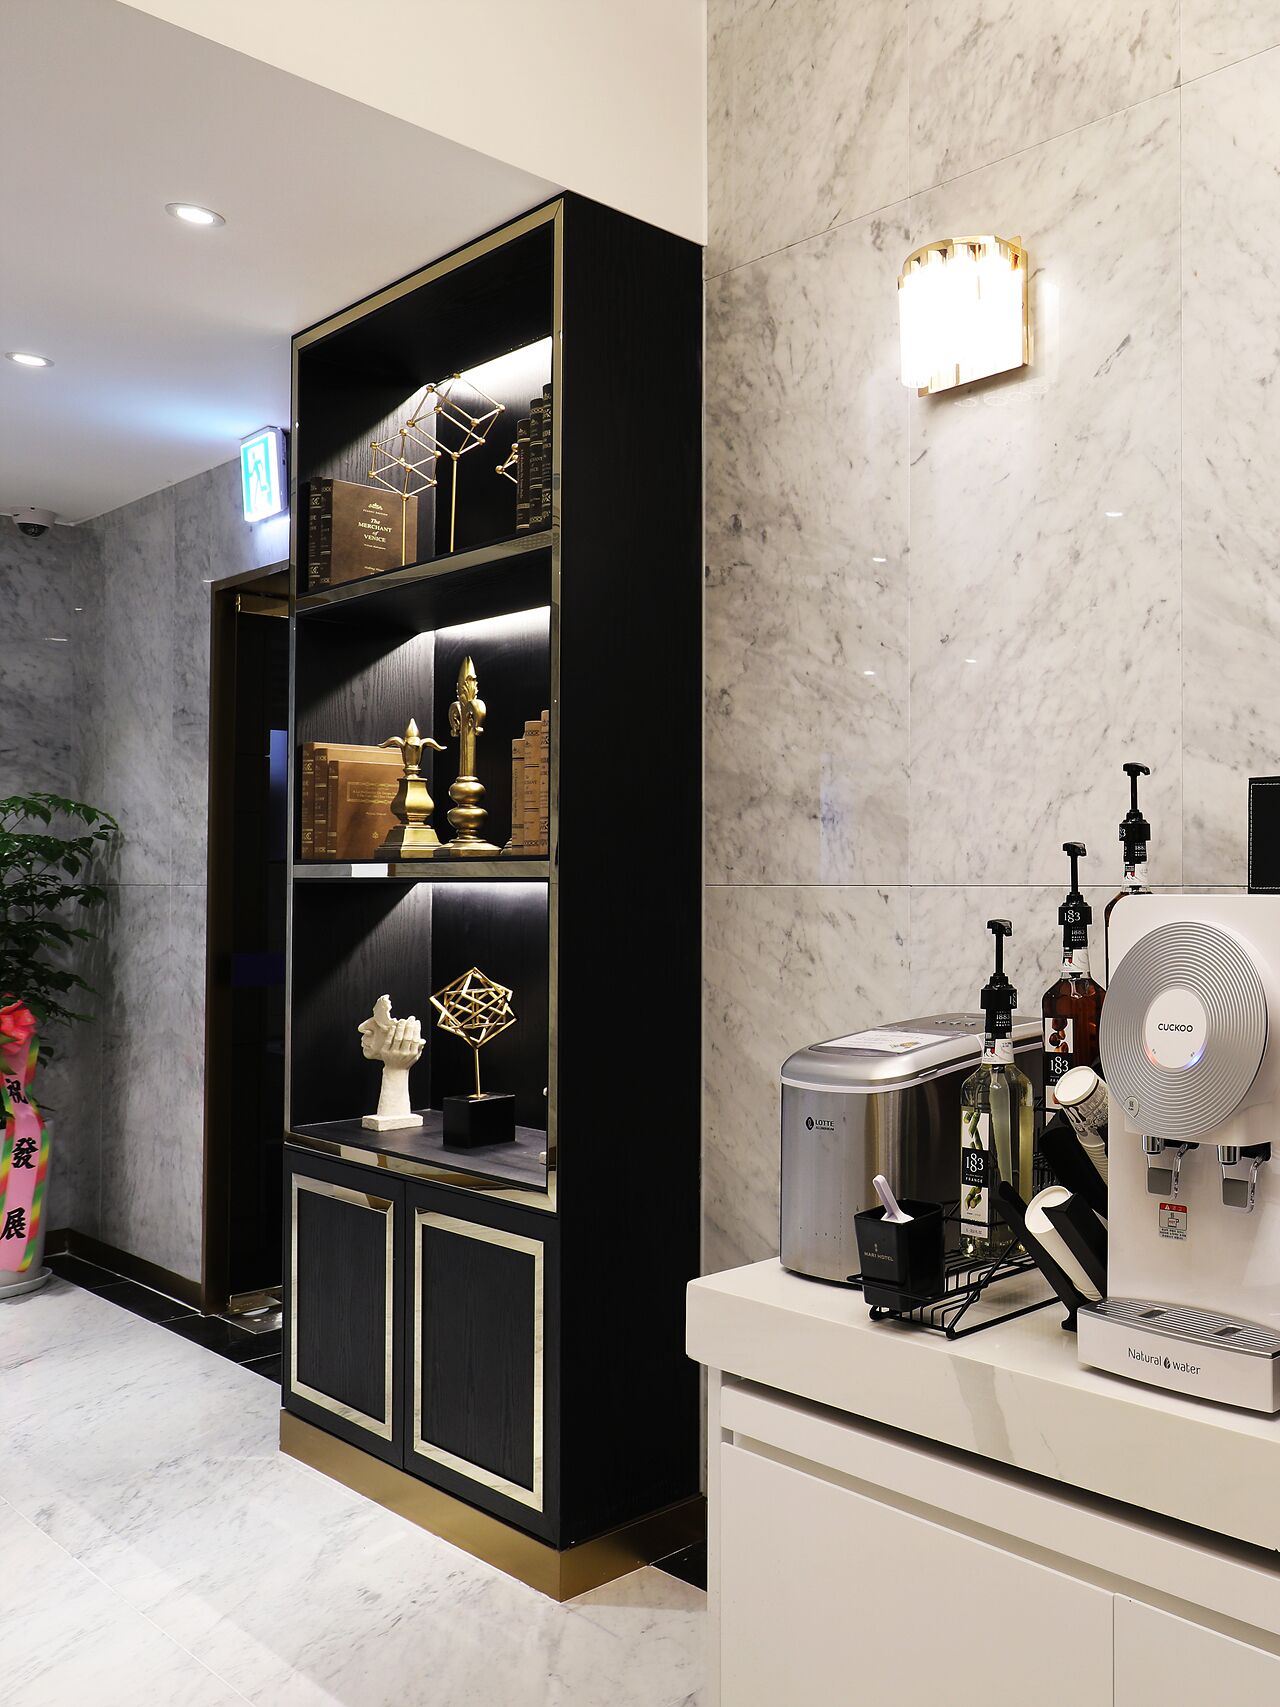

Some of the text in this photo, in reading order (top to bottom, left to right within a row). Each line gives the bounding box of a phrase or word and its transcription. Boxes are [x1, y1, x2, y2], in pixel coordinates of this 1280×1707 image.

[358, 522, 393, 533] MERCHANT
[363, 534, 387, 543] VENICE
[1157, 1023, 1194, 1033] CUCKOO
[815, 1119, 835, 1127] LOTTE
[965, 1176, 983, 1184] FRANCE
[1128, 1347, 1201, 1375] Natural water
